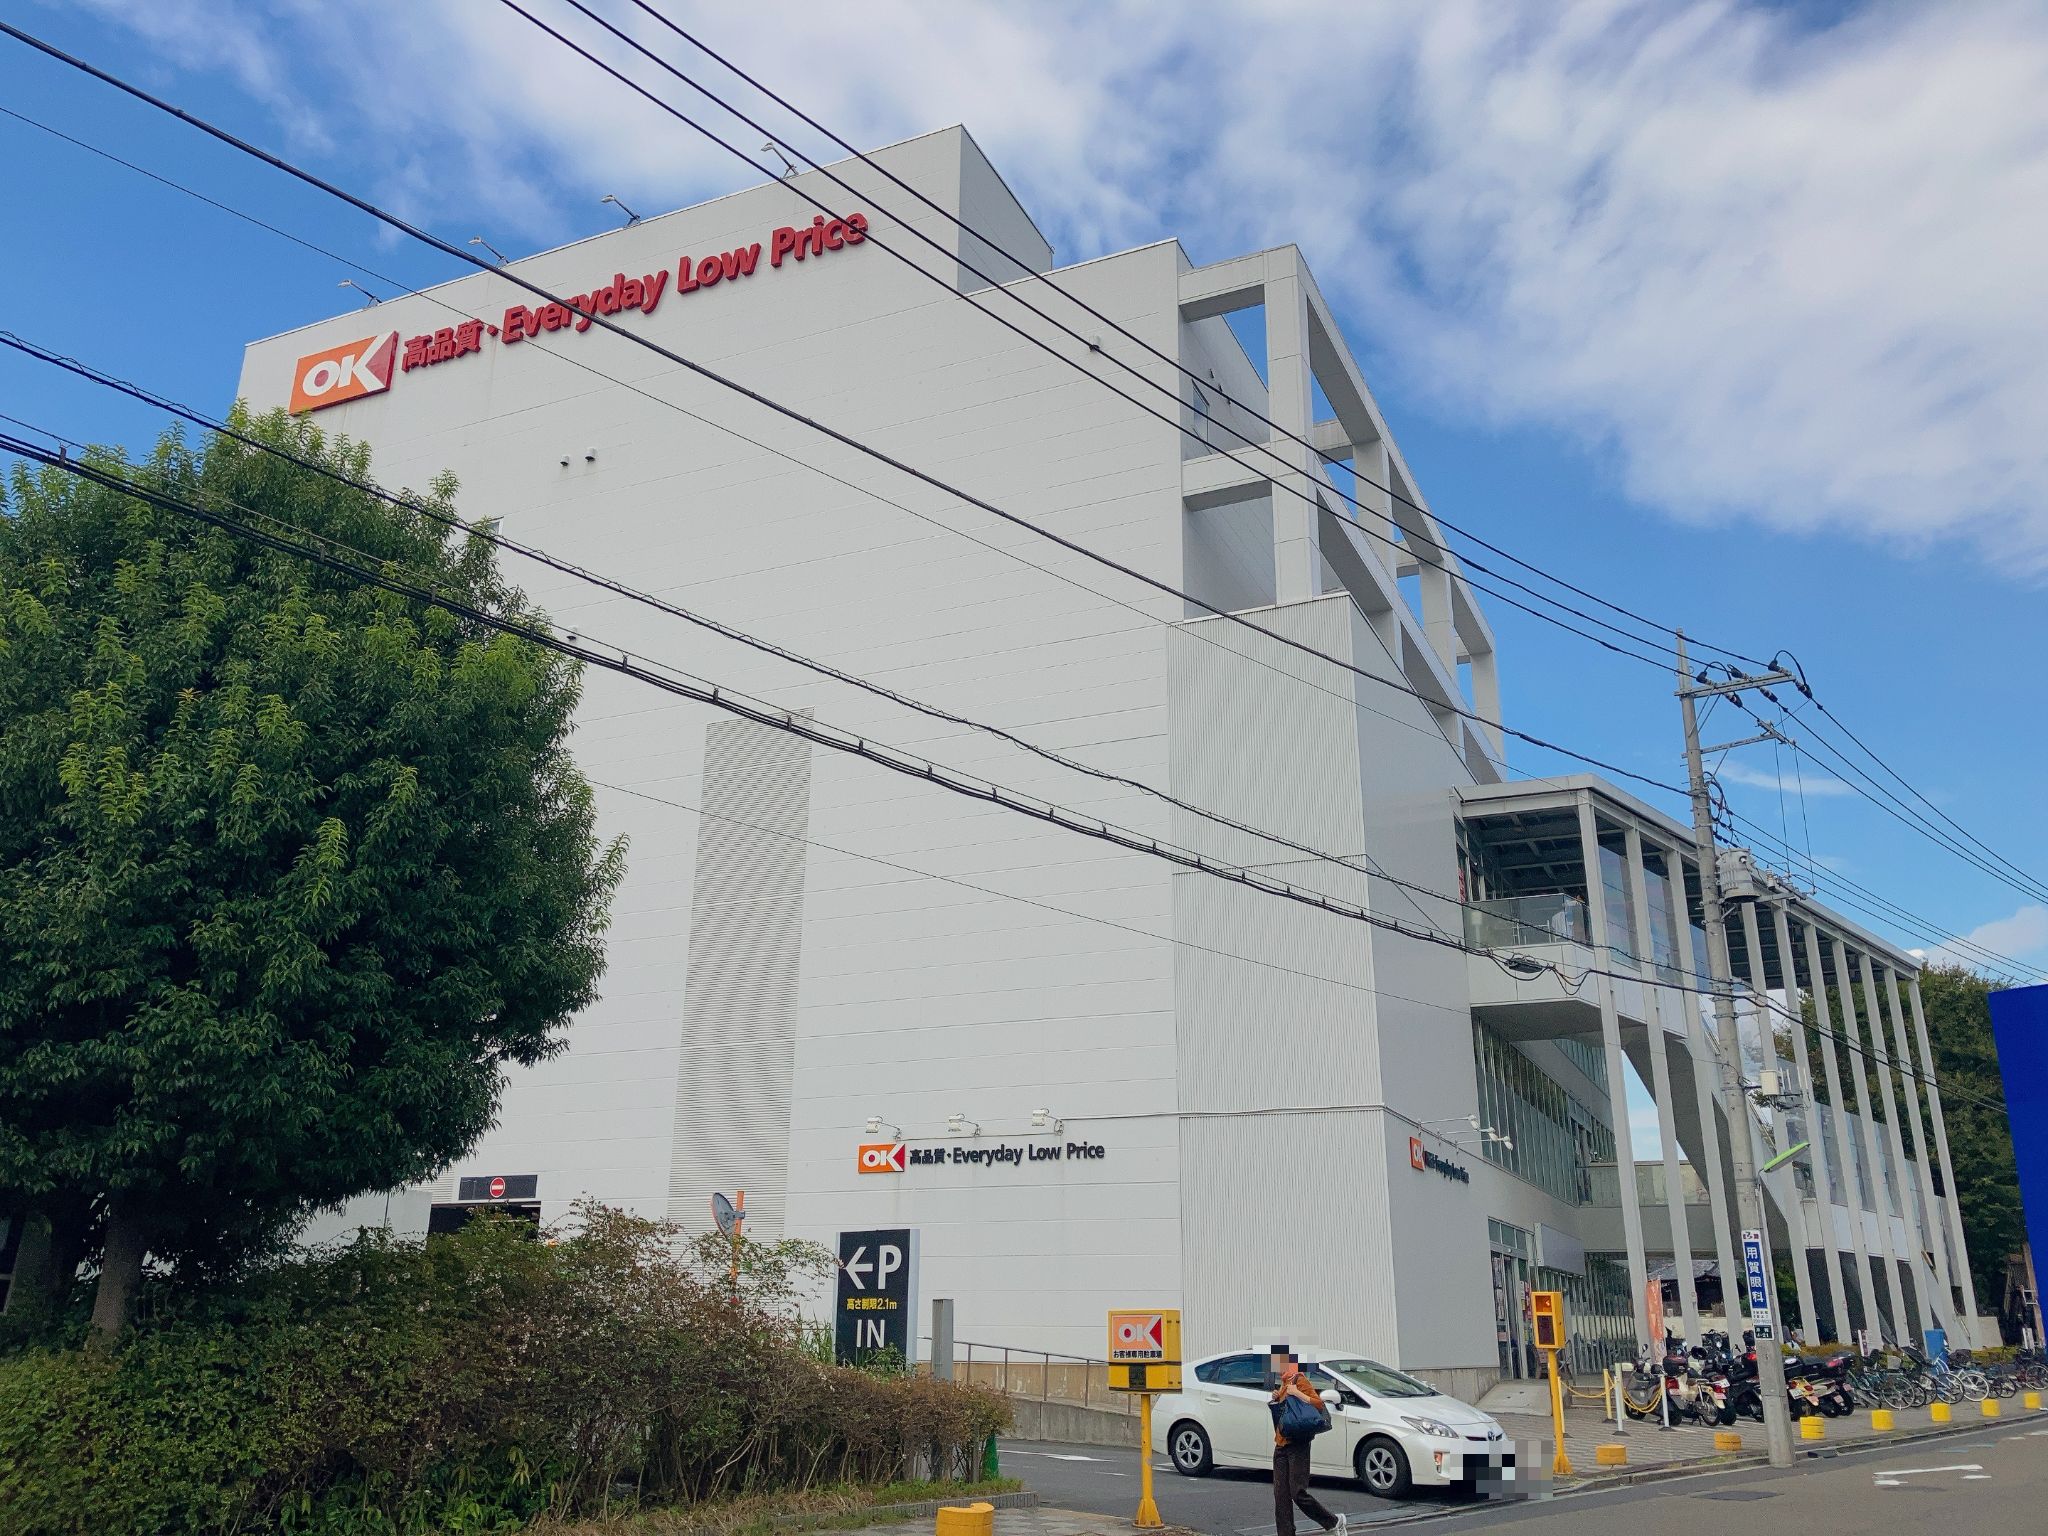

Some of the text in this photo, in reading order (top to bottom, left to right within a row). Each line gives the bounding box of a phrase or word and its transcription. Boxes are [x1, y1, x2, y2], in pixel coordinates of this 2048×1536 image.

[302, 331, 397, 397] OK
[502, 270, 668, 345] Everyday
[677, 243, 761, 295] Low
[770, 212, 869, 268] Price
[862, 1143, 905, 1172] OK
[952, 1144, 1024, 1168] Everyday
[1028, 1143, 1061, 1162] Low
[1066, 1142, 1105, 1160] Price
[877, 1244, 902, 1290] P
[856, 1319, 886, 1348] IN
[1118, 1315, 1163, 1350] OK
